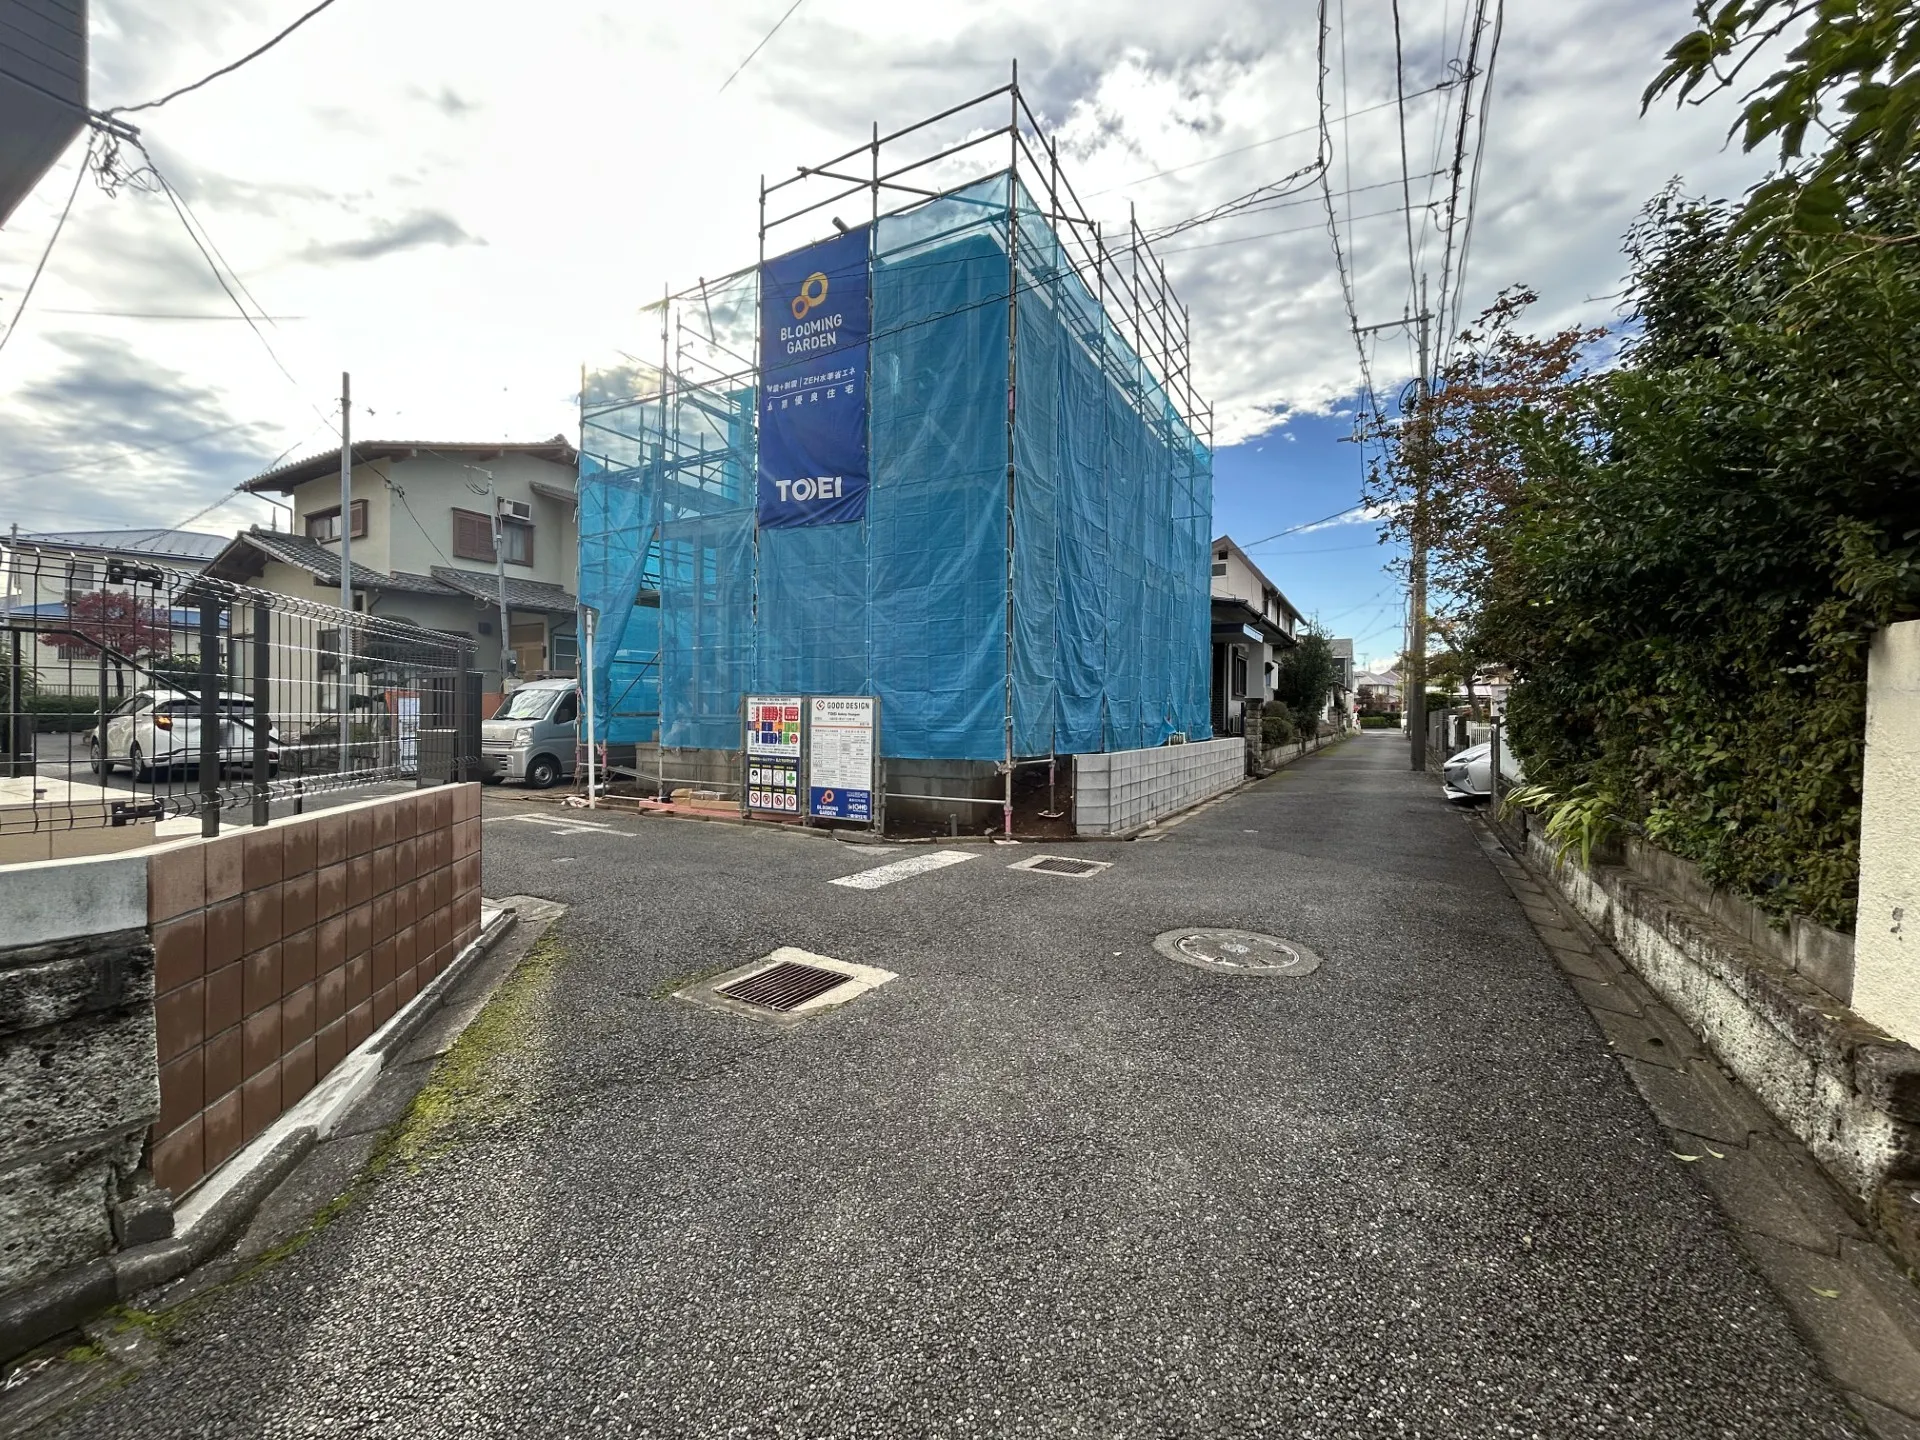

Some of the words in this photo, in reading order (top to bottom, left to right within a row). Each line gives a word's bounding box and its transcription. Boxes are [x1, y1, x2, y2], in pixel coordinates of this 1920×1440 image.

[780, 314, 842, 341] BLOOMING
[787, 331, 837, 354] GARDEN
[775, 476, 842, 502] TOEI
[827, 701, 845, 709] GOOD
